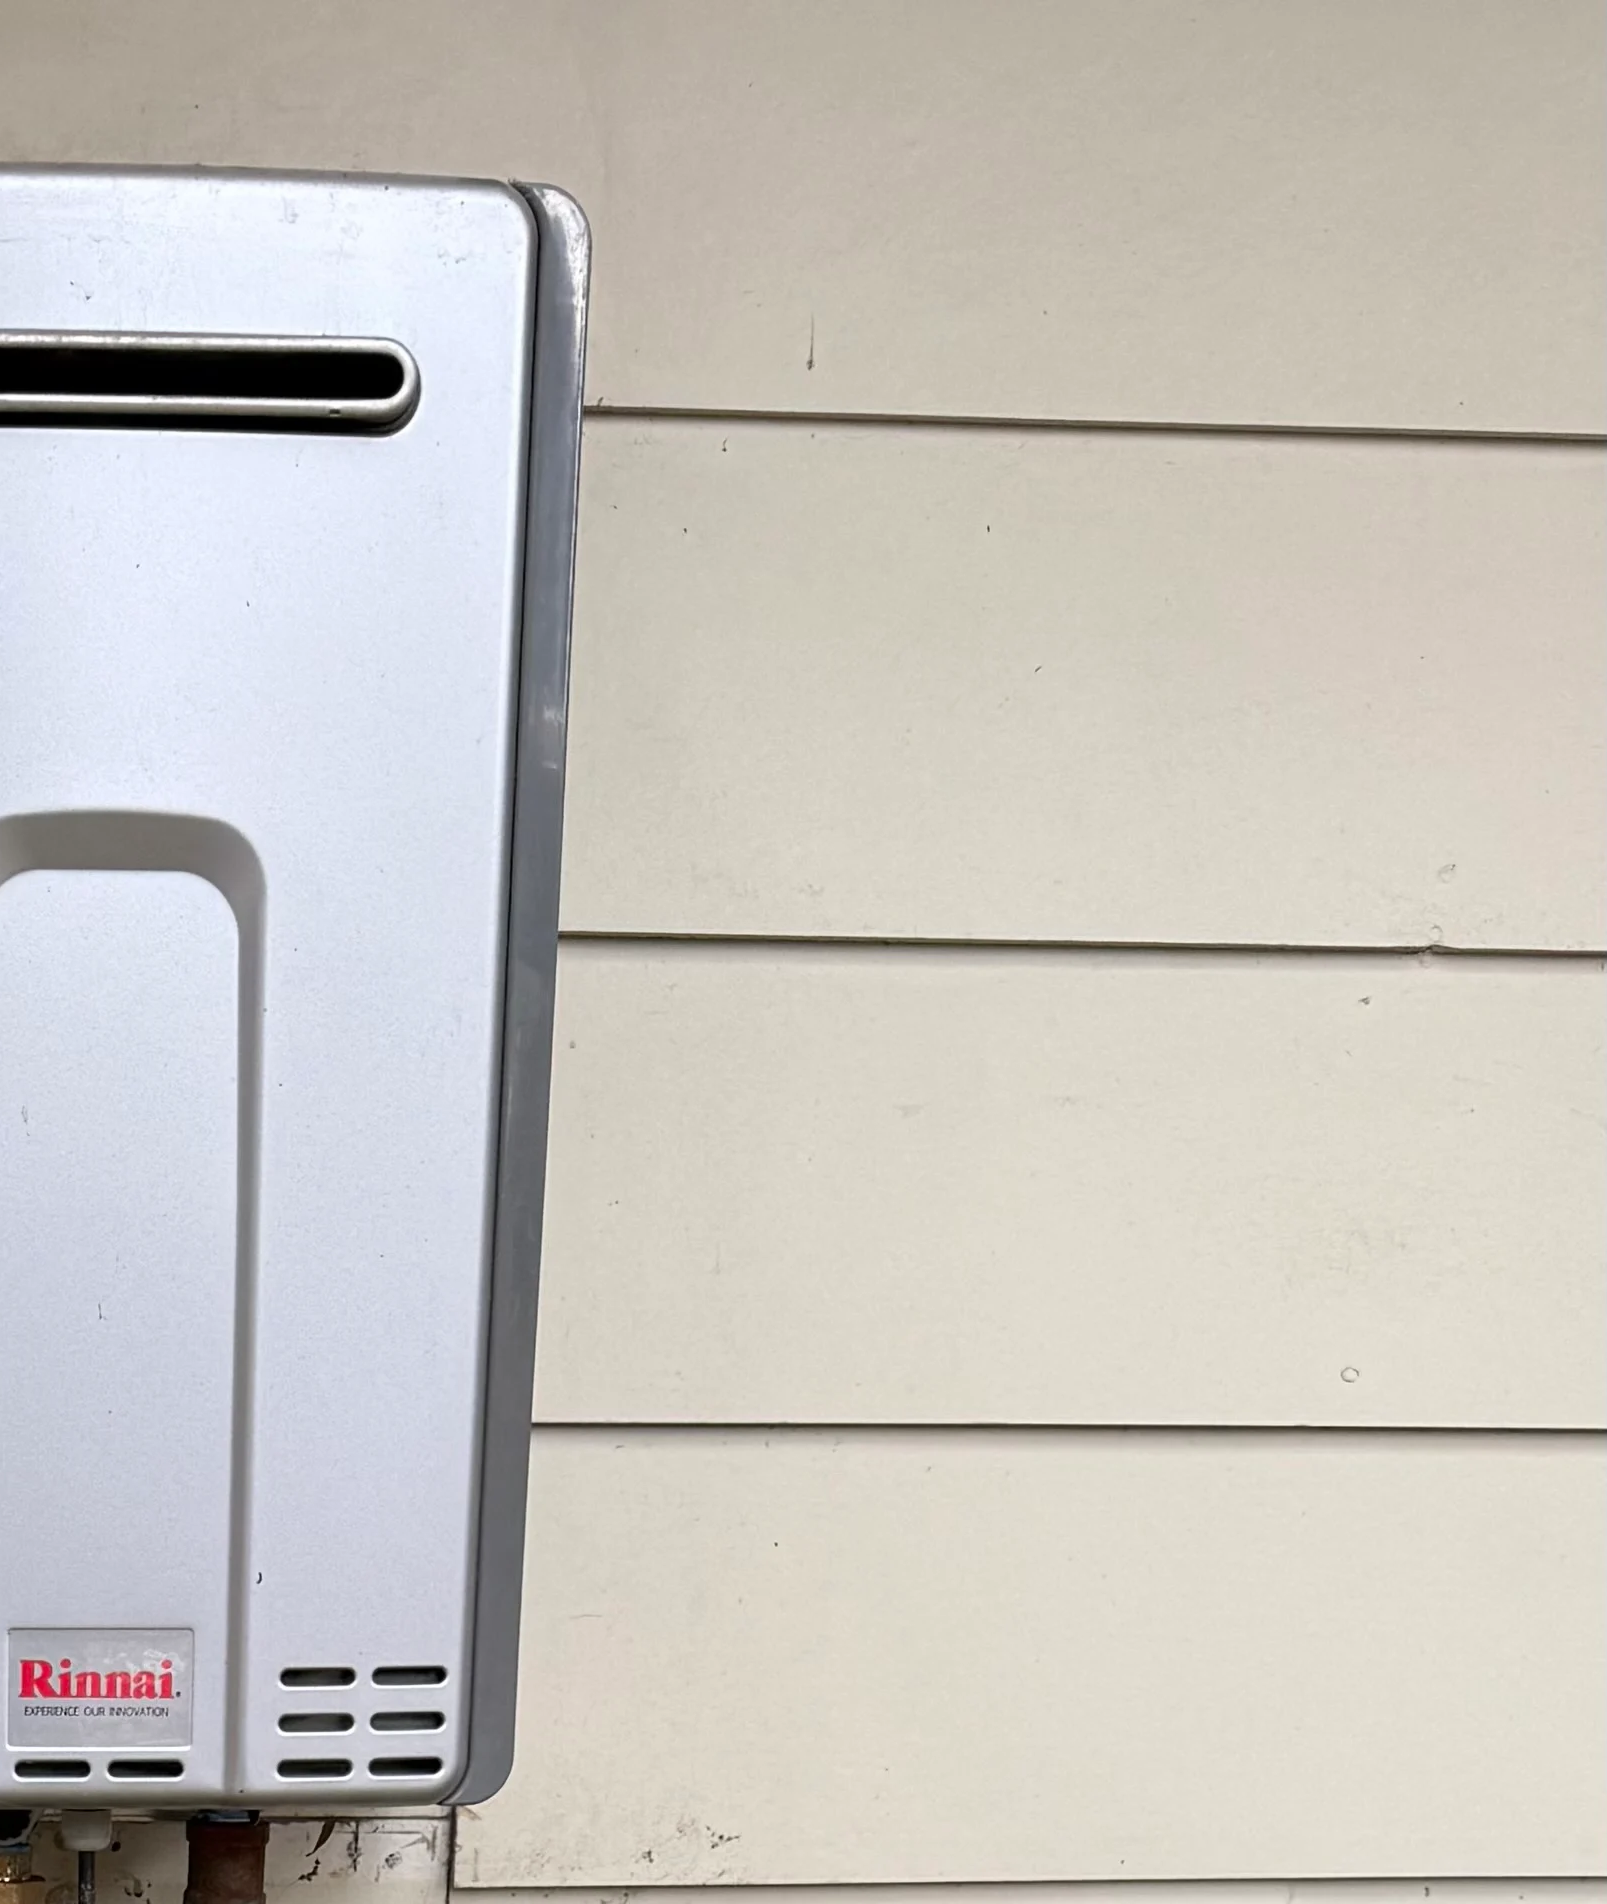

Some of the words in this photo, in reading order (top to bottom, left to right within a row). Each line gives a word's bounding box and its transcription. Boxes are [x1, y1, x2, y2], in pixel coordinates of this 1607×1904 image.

[18, 1658, 174, 1699] Rinnai
[24, 1706, 79, 1717] EXPERIENCE
[83, 1706, 106, 1717] OUR
[109, 1706, 169, 1717] INNOVATION
